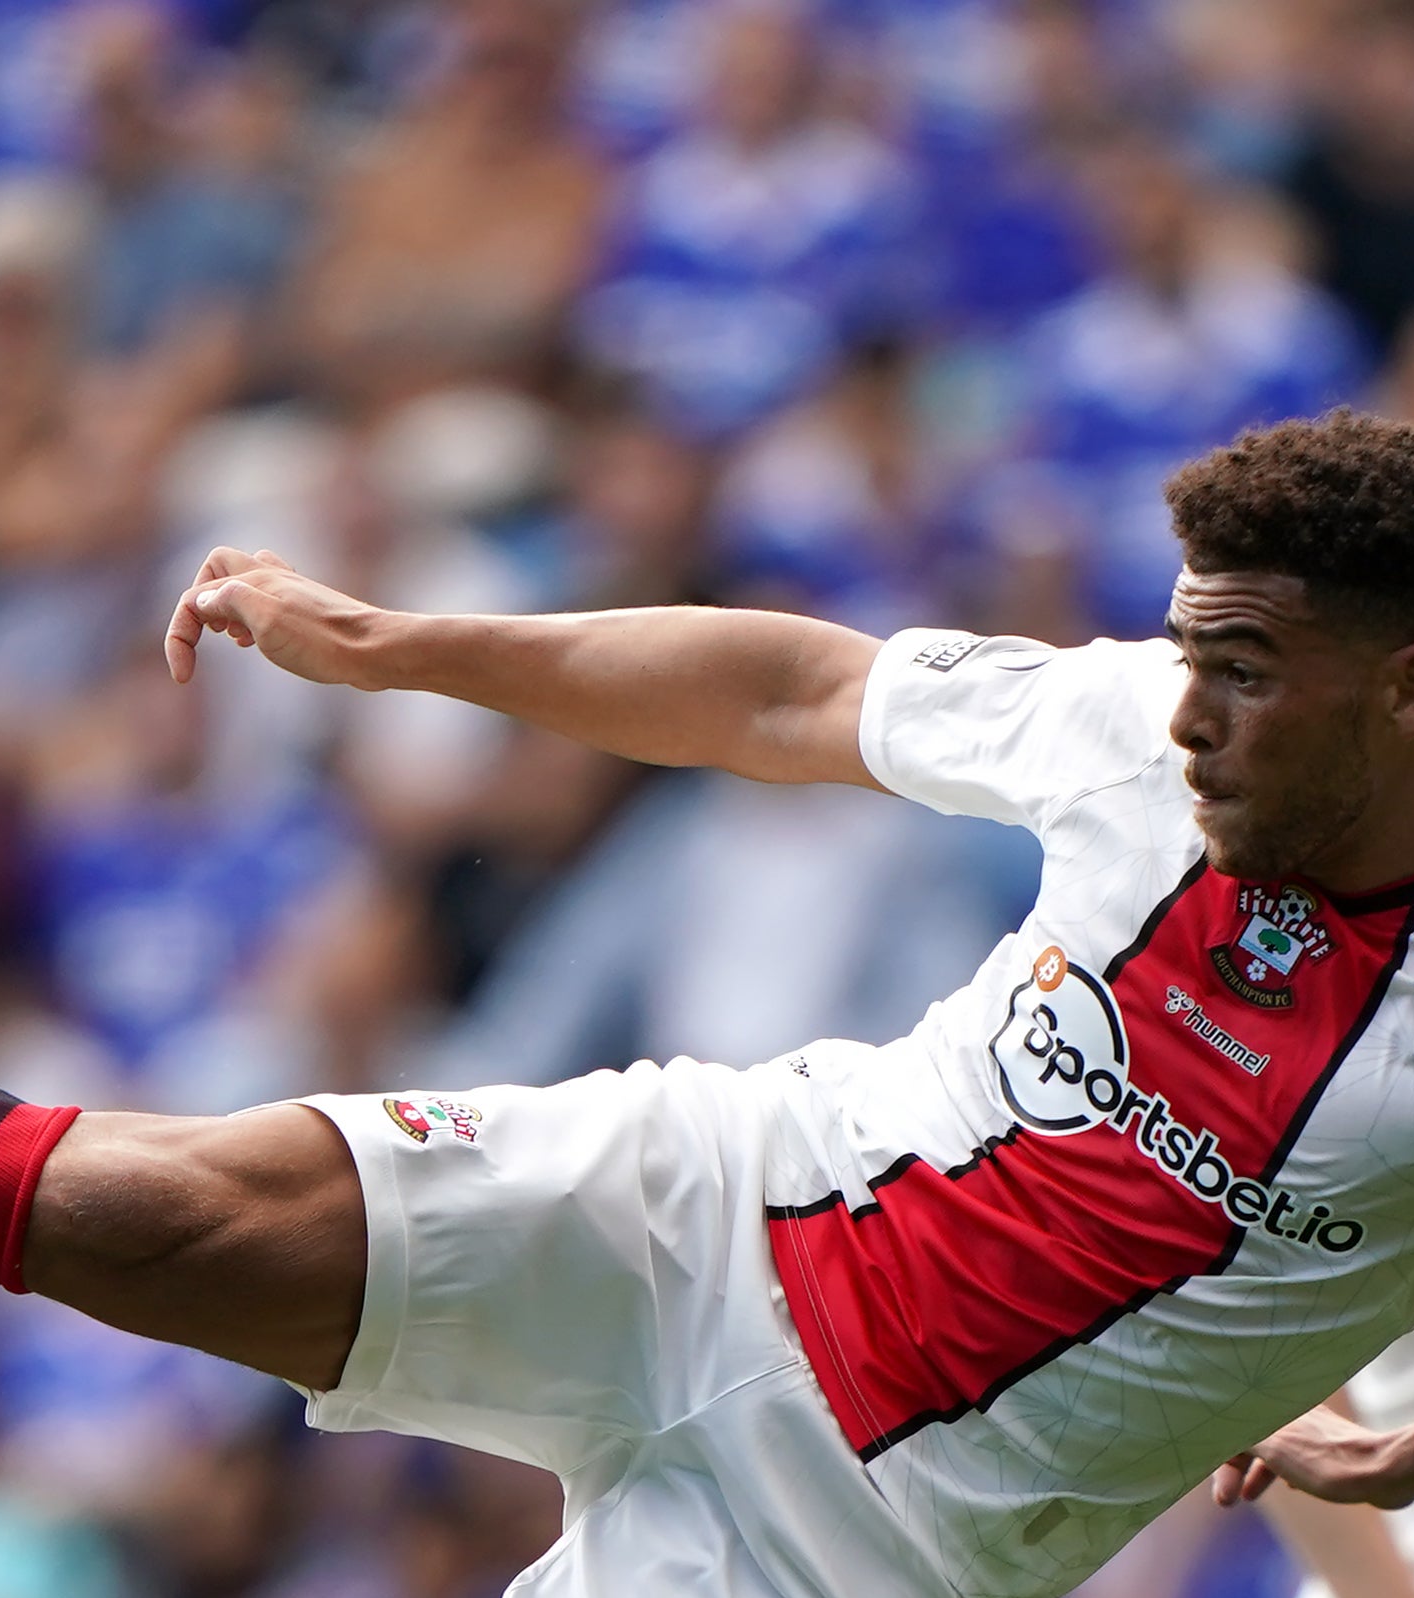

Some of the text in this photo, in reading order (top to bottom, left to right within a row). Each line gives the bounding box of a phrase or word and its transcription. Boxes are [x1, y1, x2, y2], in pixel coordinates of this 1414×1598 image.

[1213, 951, 1289, 1006] SOUTHAMPTON FC
[1184, 1005, 1270, 1076] hummel
[1024, 1003, 1364, 1253] Sportsbet.io
